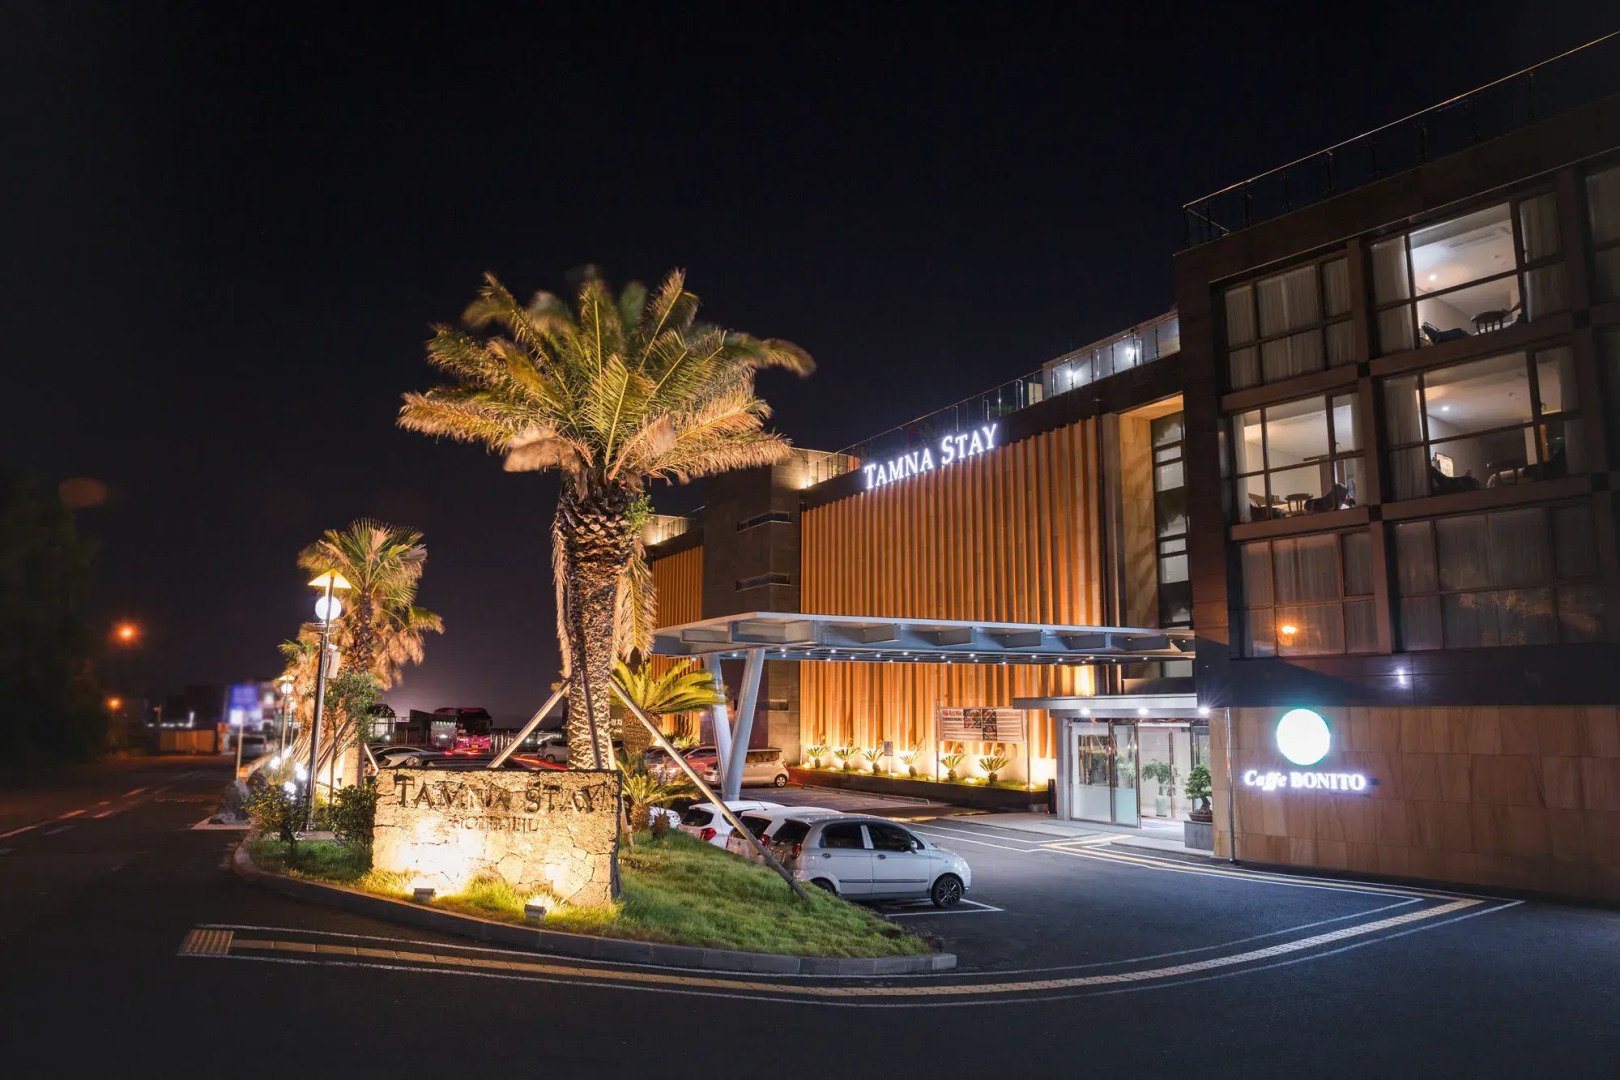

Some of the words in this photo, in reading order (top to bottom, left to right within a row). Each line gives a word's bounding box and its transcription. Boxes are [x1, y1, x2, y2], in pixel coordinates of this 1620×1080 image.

[864, 448, 934, 490] TAMNA
[941, 423, 997, 465] STAY
[524, 780, 607, 813] STAY
[1244, 769, 1287, 791] Caffe
[1290, 771, 1366, 791] BONITO
